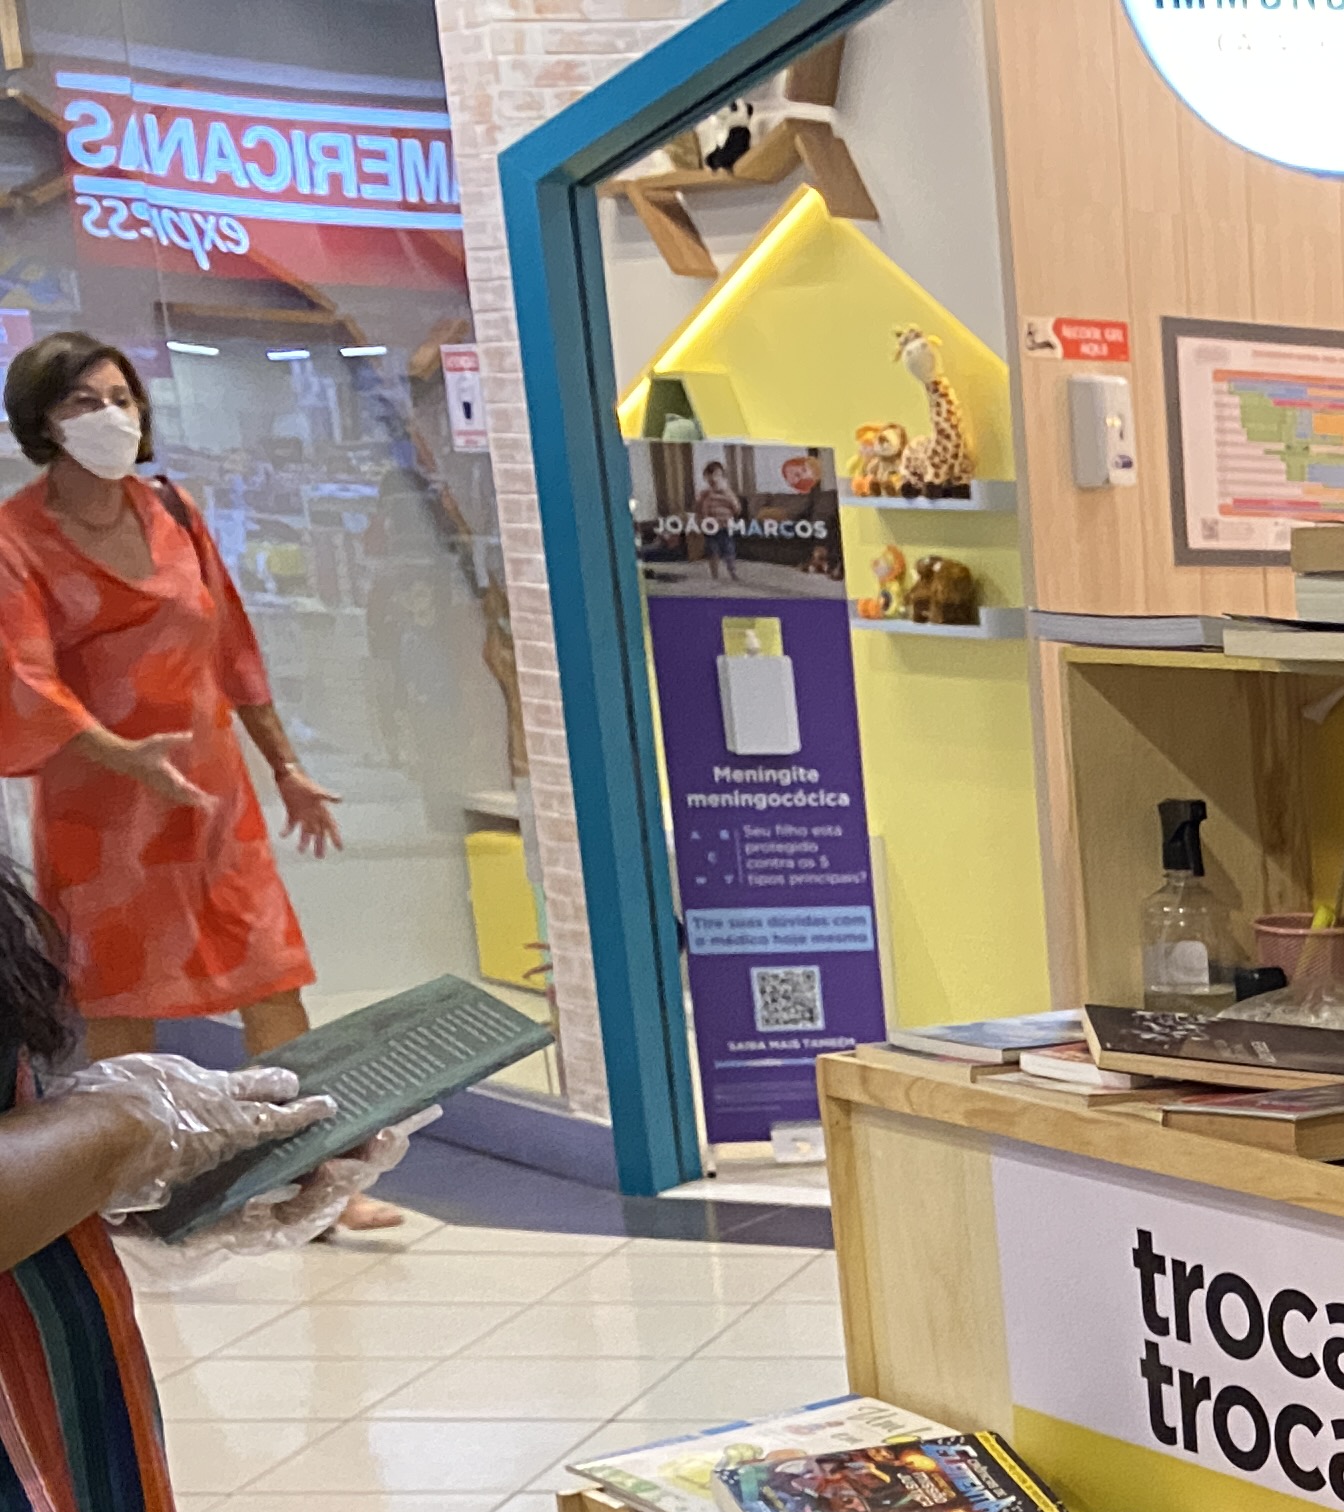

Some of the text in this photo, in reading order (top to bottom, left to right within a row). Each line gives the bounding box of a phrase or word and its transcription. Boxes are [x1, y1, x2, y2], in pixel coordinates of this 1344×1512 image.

[653, 512, 829, 540] JOÃO MARCOS
[712, 765, 821, 787] Meningite
[686, 788, 851, 811] meningocócica
